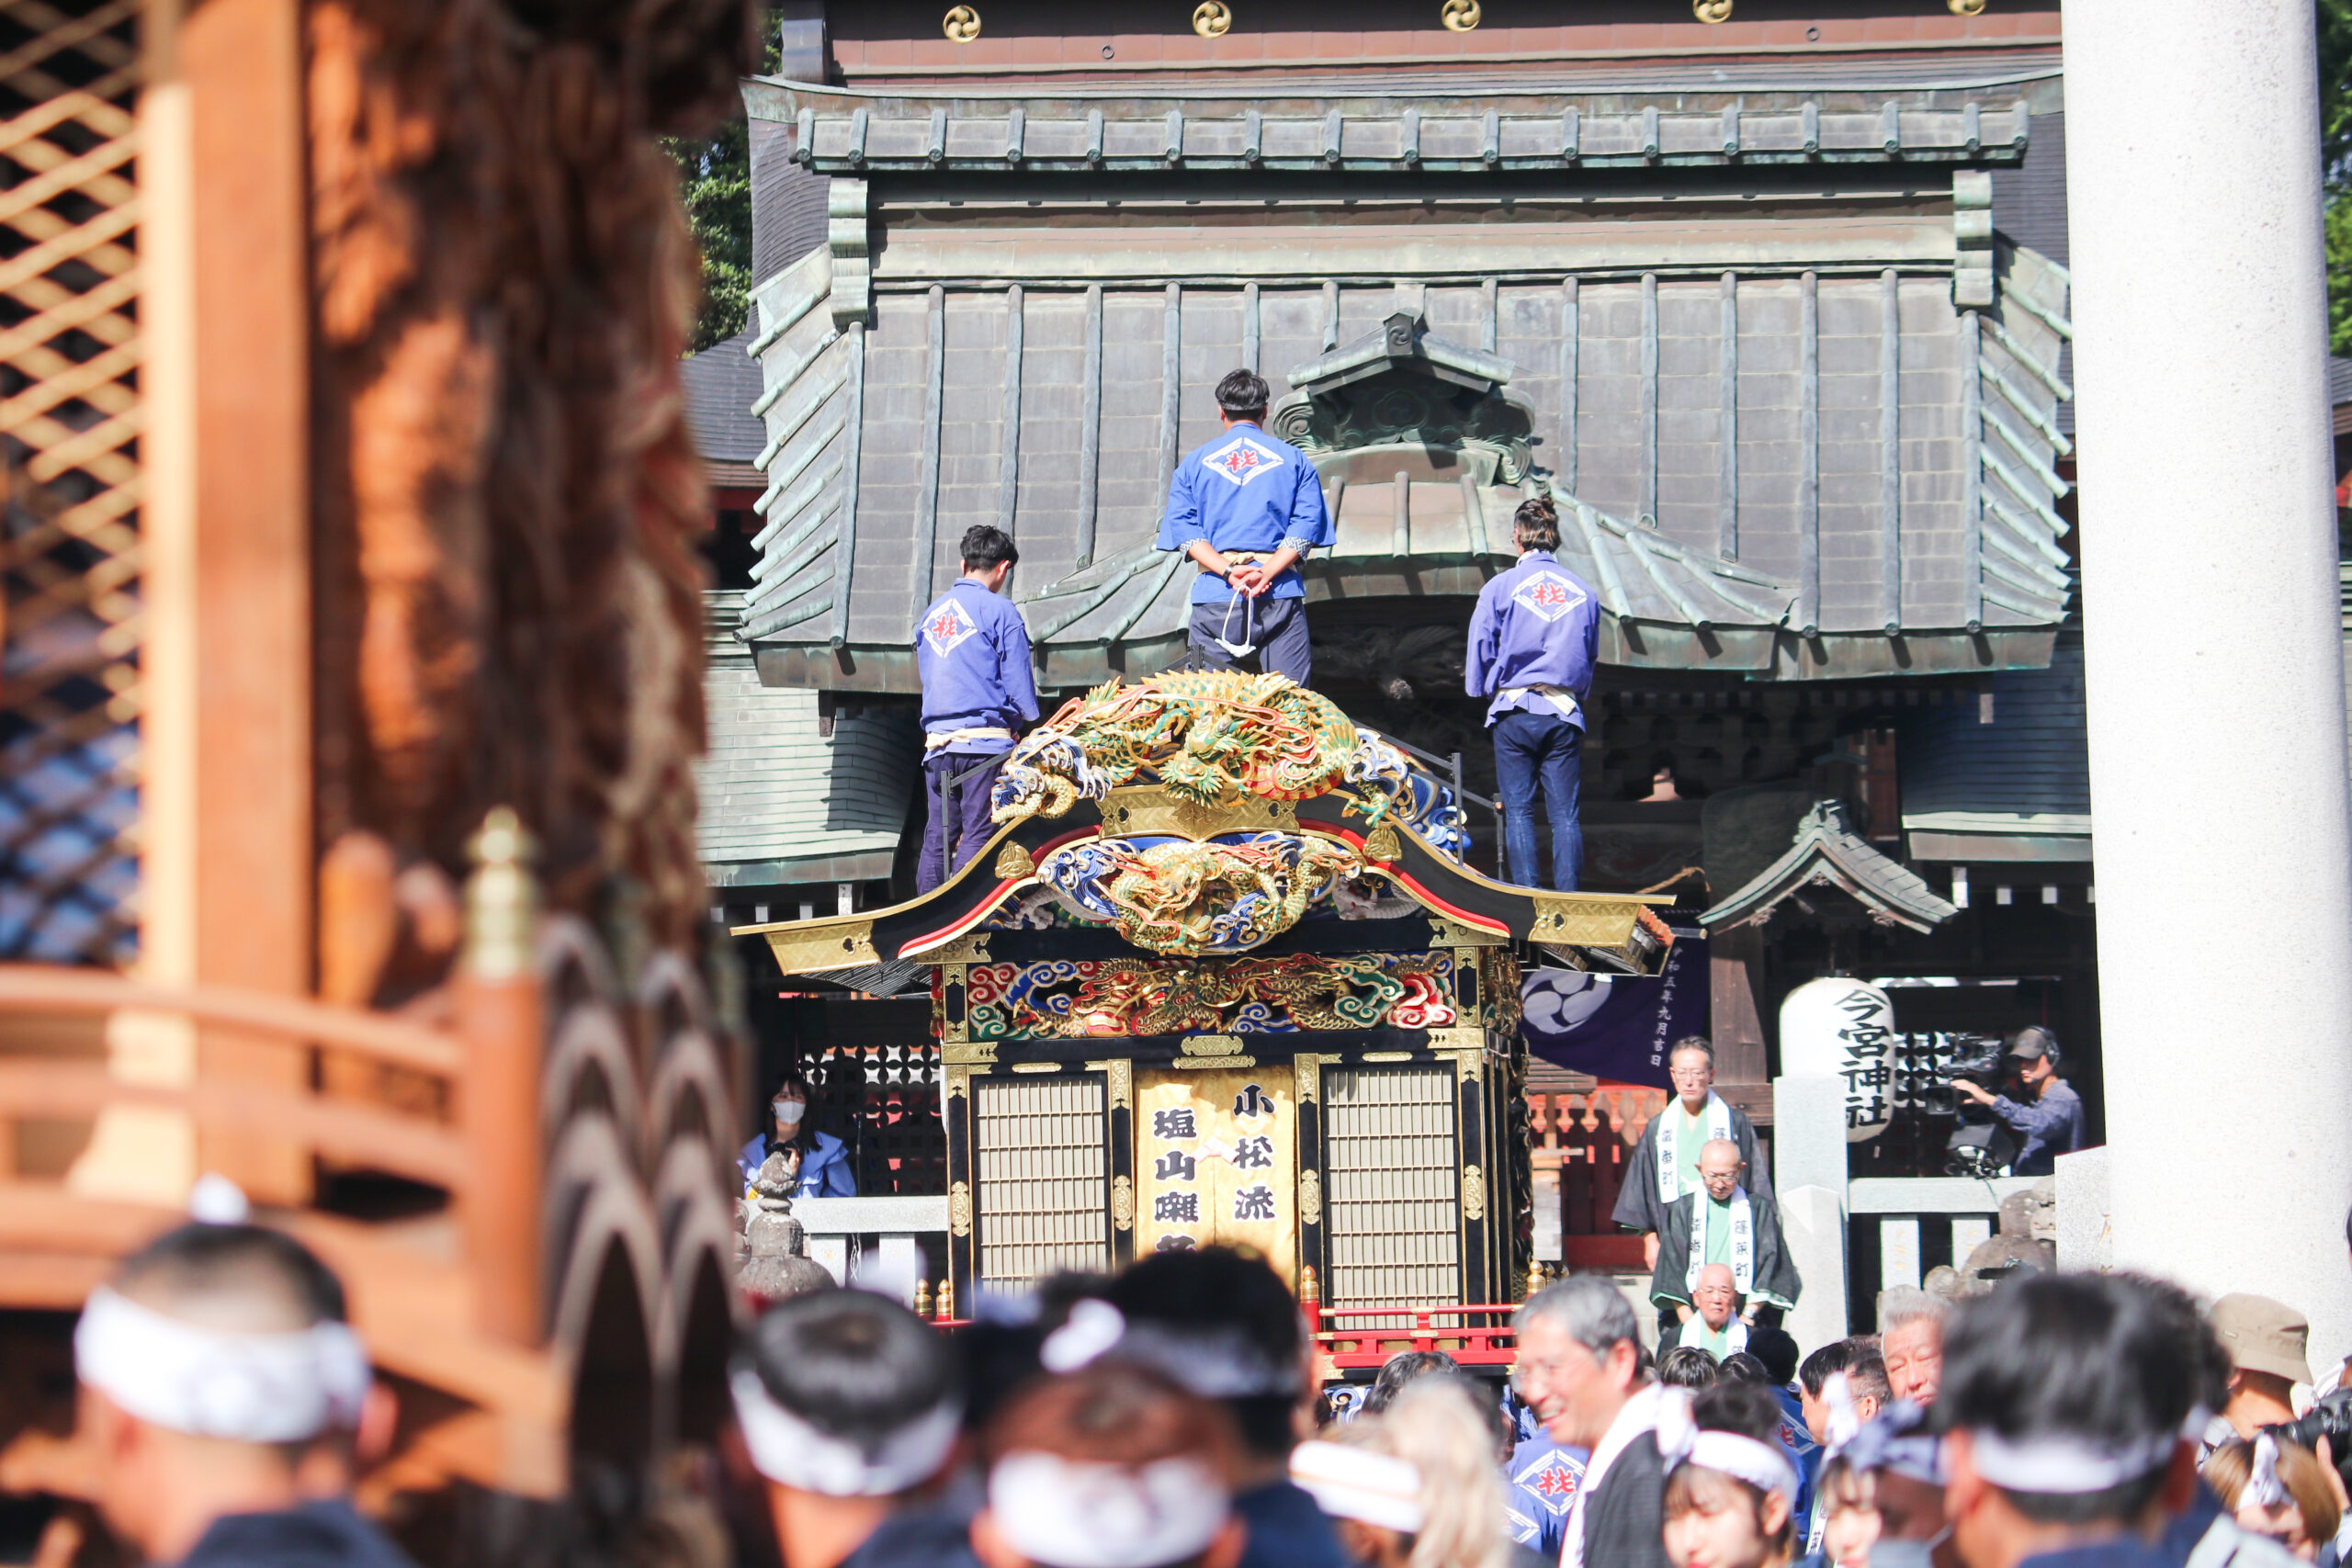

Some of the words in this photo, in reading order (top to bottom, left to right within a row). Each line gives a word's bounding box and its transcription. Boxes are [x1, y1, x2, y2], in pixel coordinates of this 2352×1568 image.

[1833, 989, 1892, 1129] 今宮神社
[1233, 1085, 1276, 1220] 小松流
